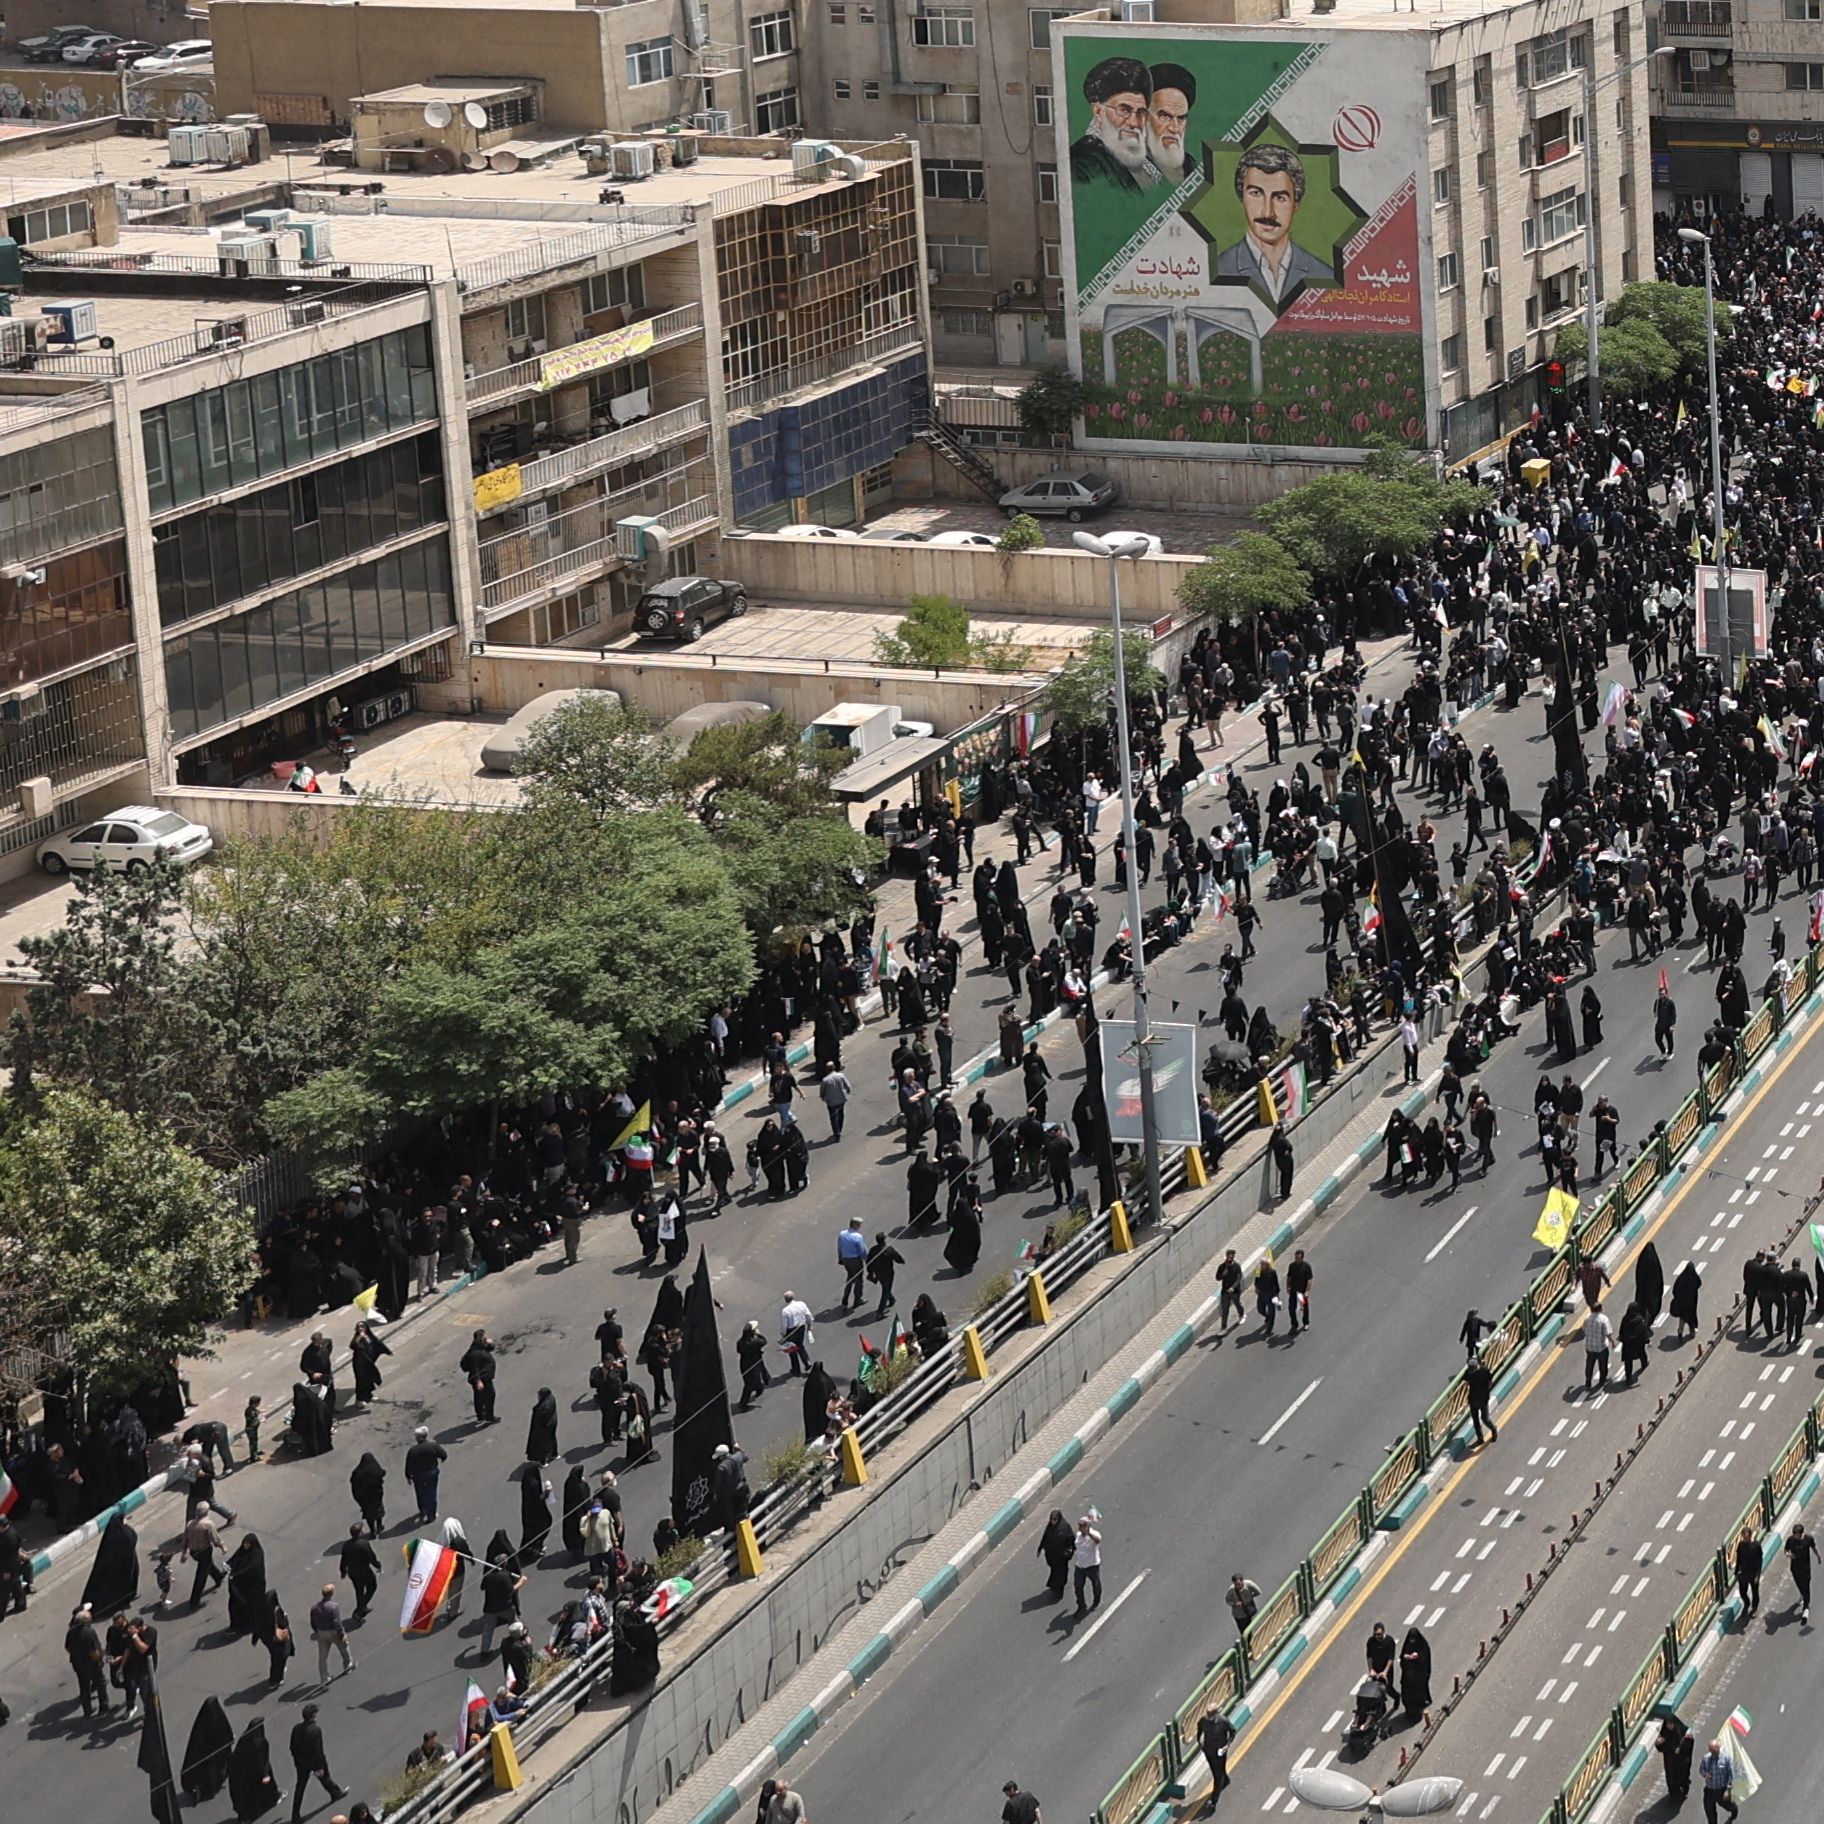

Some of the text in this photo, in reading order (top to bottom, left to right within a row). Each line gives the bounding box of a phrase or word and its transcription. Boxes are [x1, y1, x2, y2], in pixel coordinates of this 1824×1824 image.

[1775, 129, 1791, 142] ایران
[1790, 129, 1799, 142] ملی
[1136, 256, 1200, 280] شهادت
[1357, 259, 1410, 288] شهید
[1112, 279, 1200, 299] هنر مردان خداست
[1358, 289, 1387, 305] کامران
[1387, 291, 1410, 303] استاد
